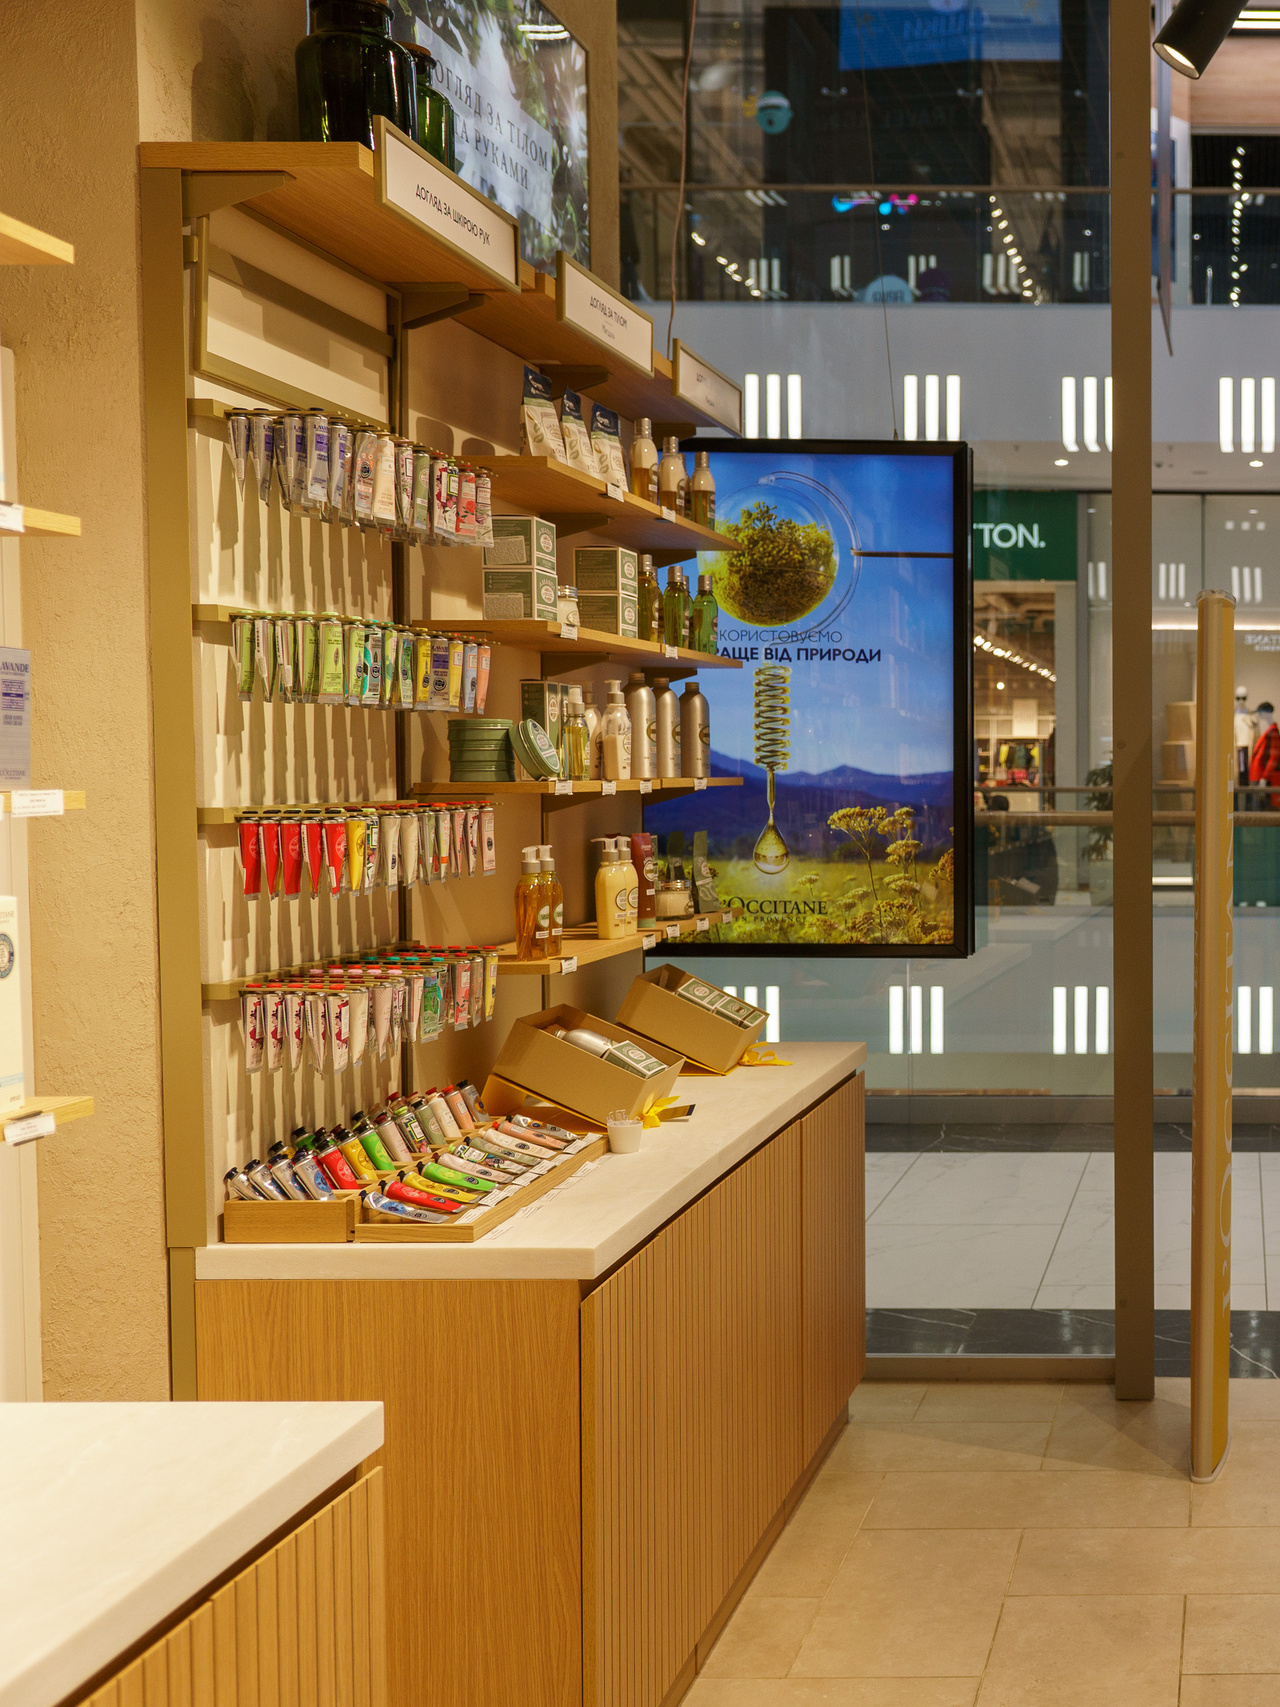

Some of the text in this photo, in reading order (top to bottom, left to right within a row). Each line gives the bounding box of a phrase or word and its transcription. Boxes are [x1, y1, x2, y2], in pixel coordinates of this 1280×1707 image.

[434, 59, 549, 172] ОГЛЯД ЗА ТІЛОМ
[454, 111, 528, 190] ТА РУКАМИ
[416, 184, 491, 246] ДОГЛЯД ЗА ШКІРОЮ РУК
[973, 522, 1046, 549] TON.
[719, 629, 843, 645] КОРИСТОВУЄМО
[764, 647, 792, 663] ВІД
[797, 648, 882, 664] ПРИРОДИ
[722, 896, 828, 915] 'OCCITANE
